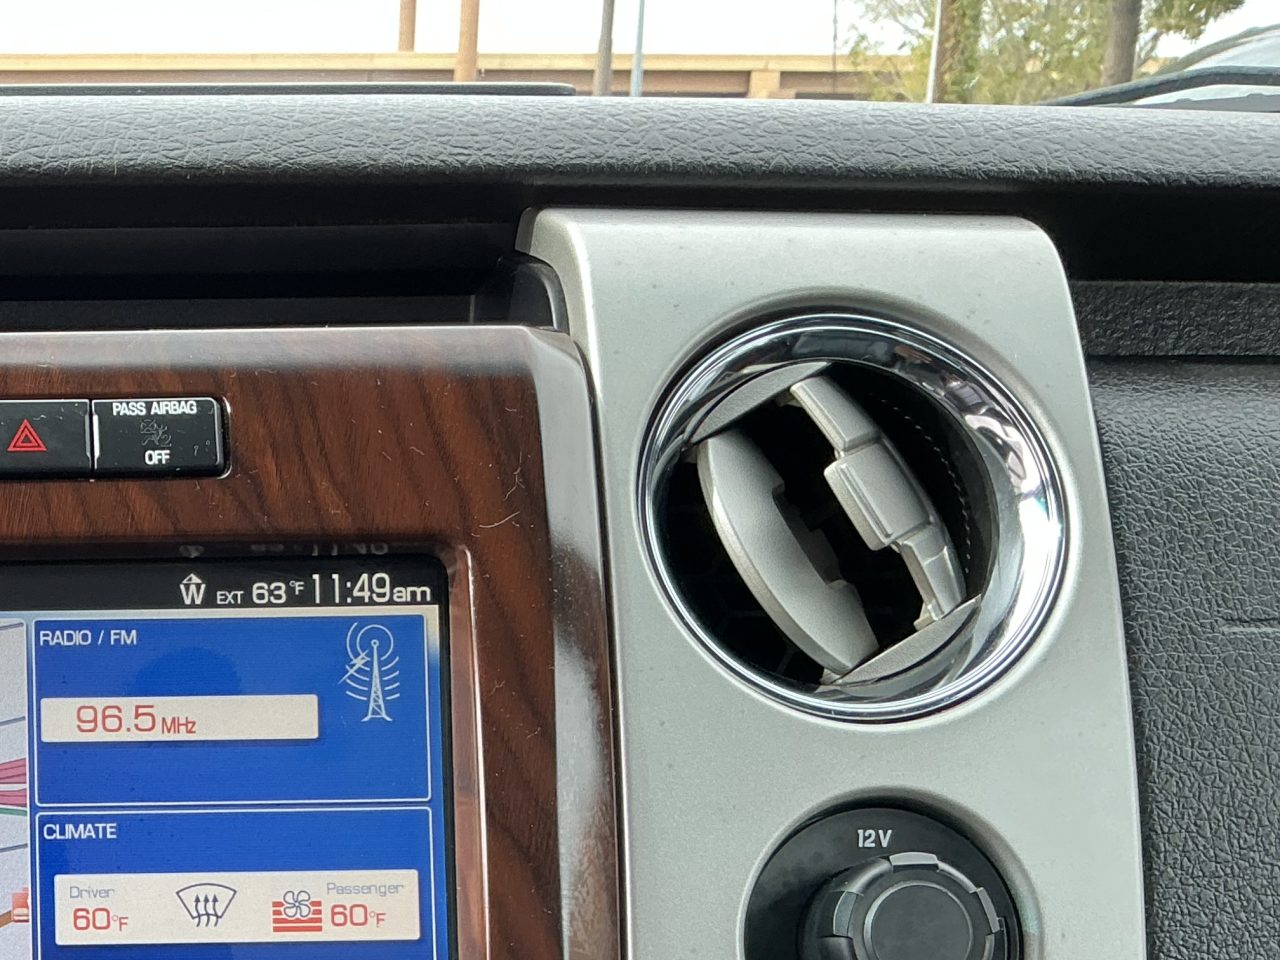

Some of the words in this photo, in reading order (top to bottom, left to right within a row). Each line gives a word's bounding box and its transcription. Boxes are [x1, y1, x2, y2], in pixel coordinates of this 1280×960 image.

[112, 402, 146, 416] PASS
[150, 401, 197, 415] AIRBAG
[144, 449, 171, 465] OFF
[179, 583, 206, 605] W
[216, 591, 244, 604] EXT
[39, 630, 92, 646] RADIO
[110, 629, 138, 645] FM
[75, 705, 156, 733] 96.5
[161, 717, 197, 735] MHz
[43, 823, 117, 840] CLIMATE
[857, 829, 893, 848] 12V
[69, 885, 115, 900] Driver
[326, 882, 405, 898] Passenger
